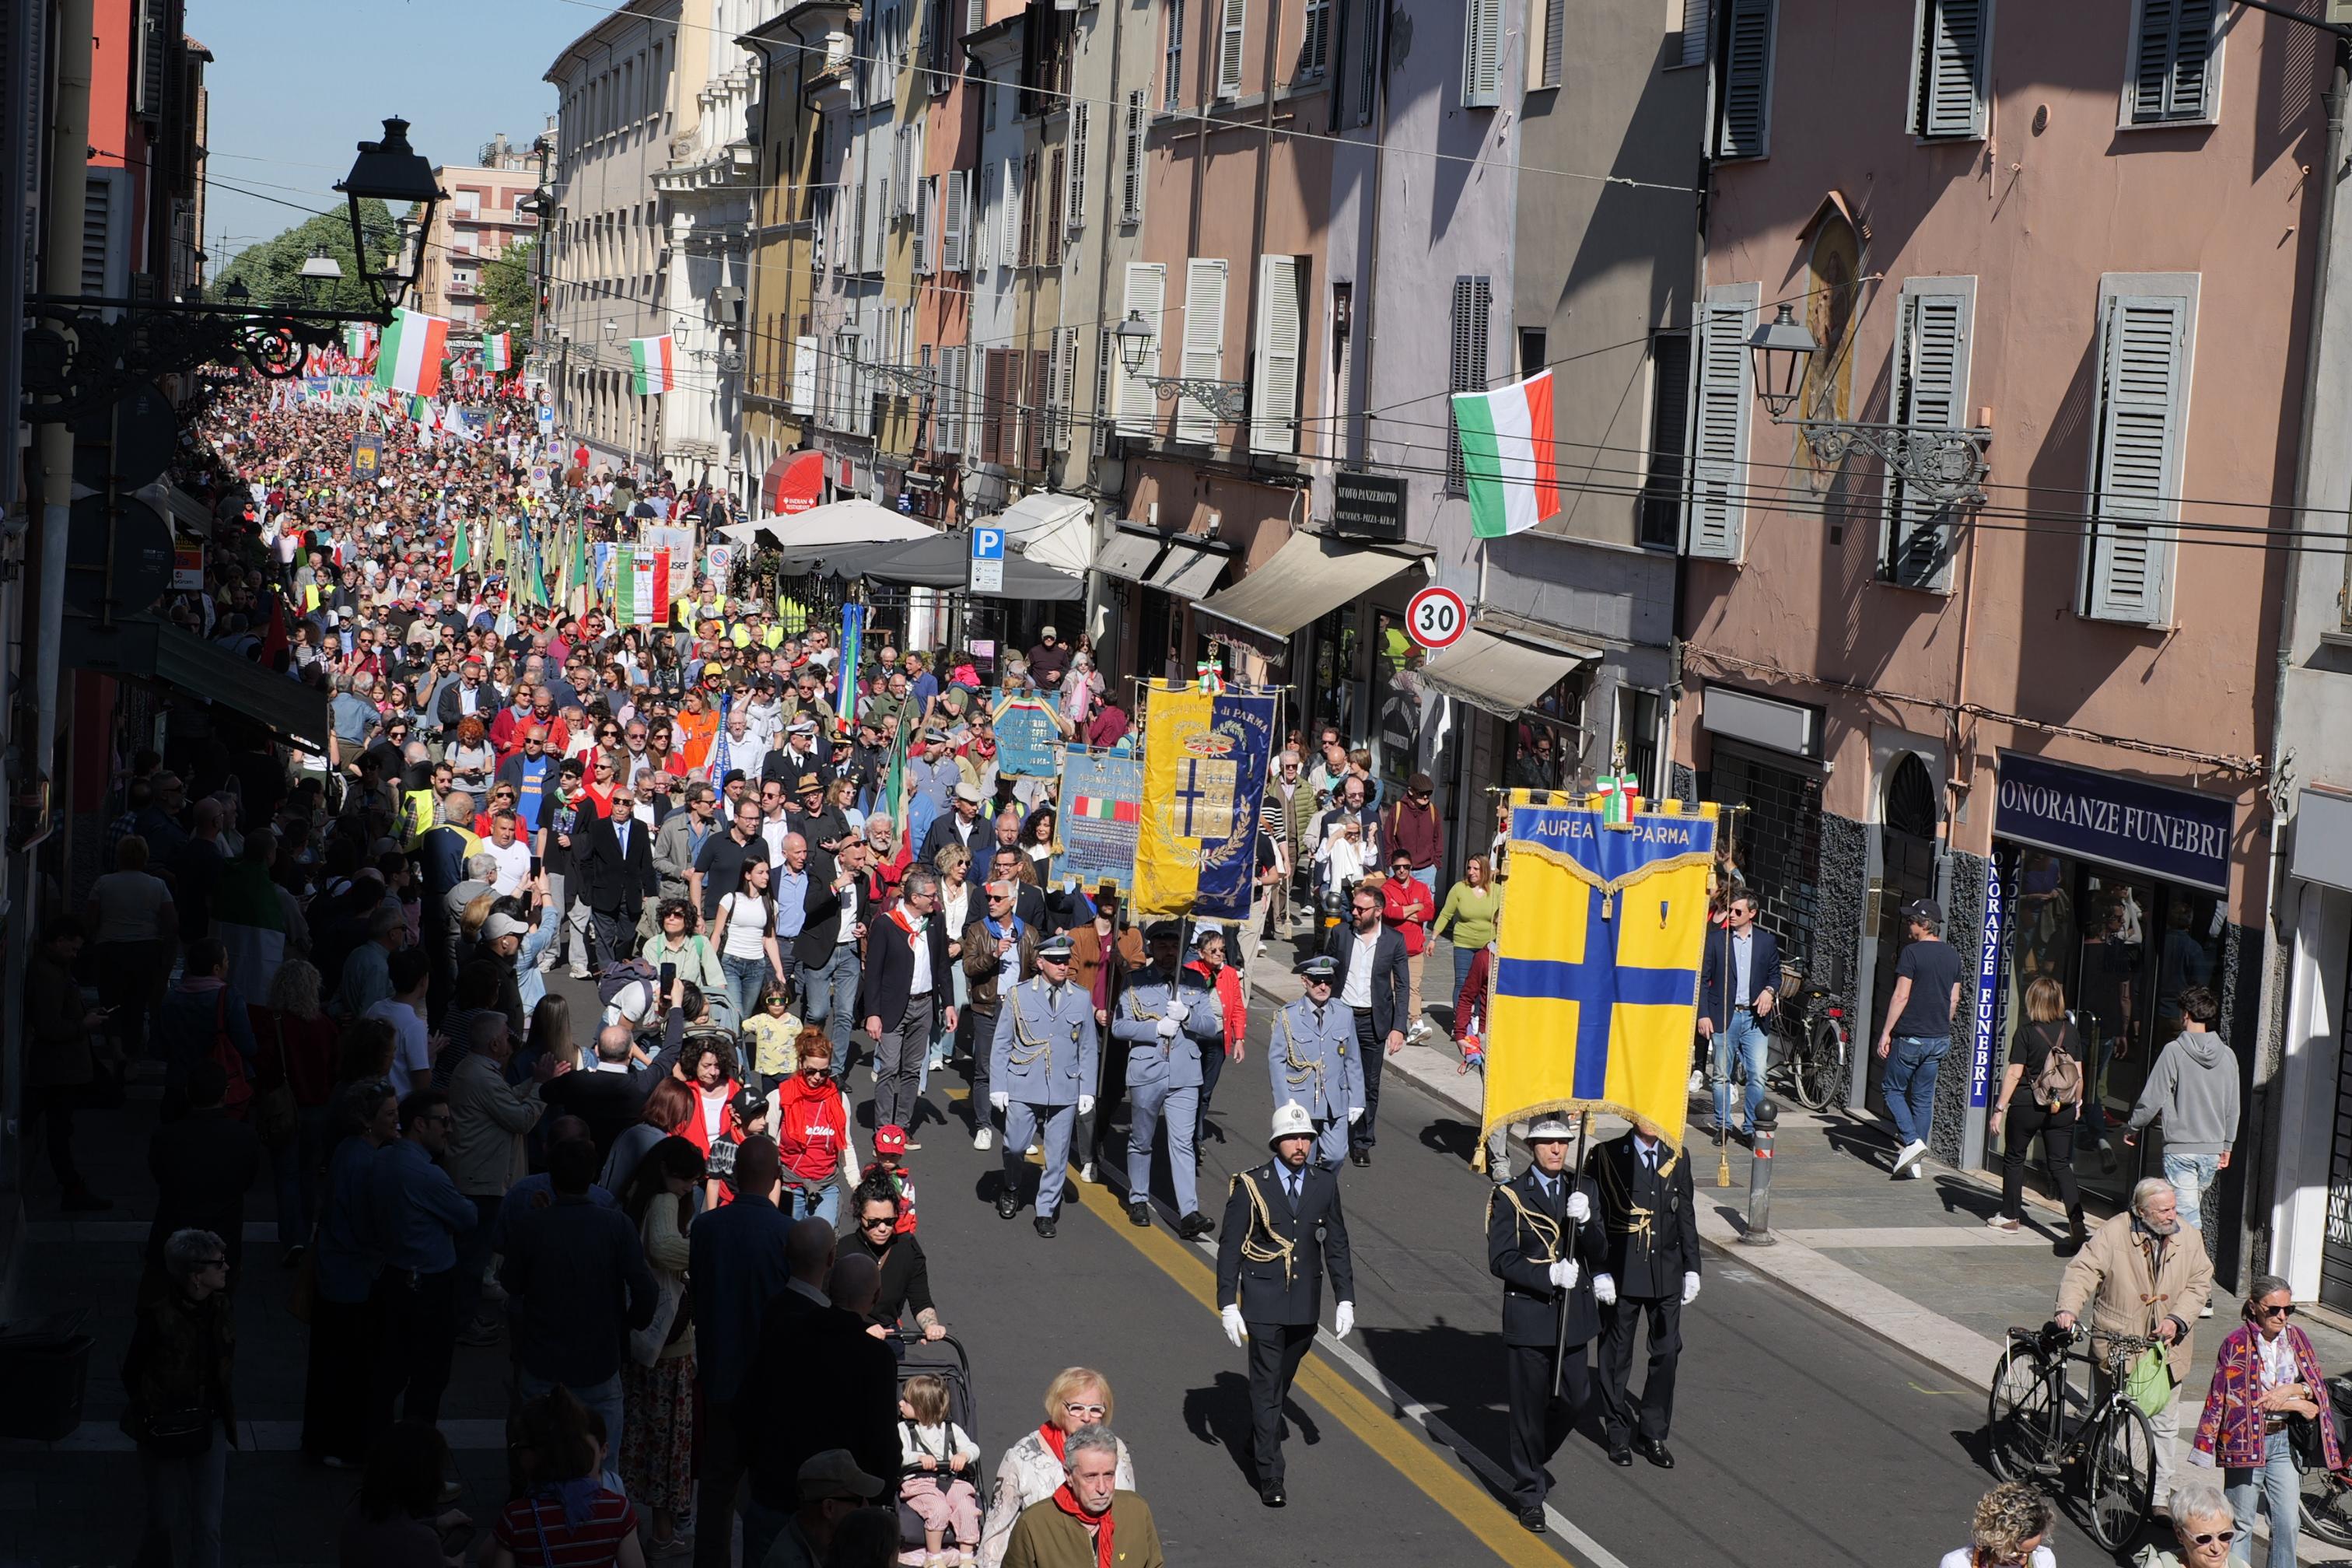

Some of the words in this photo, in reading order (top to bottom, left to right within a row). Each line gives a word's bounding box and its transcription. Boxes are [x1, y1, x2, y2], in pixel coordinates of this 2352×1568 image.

[542, 408, 550, 419] P
[1337, 487, 1358, 499] NUOVO
[1358, 488, 1398, 504] PANZEROTTO
[1336, 510, 1360, 522] COUSCOUS
[1363, 514, 1377, 523] PIZZA
[978, 530, 999, 556] P
[670, 562, 689, 570] user
[1420, 604, 1454, 632] 30
[1220, 705, 1230, 716] di
[1233, 709, 1269, 733] PARMA
[1536, 819, 1594, 839] AUREA
[1632, 825, 1690, 845] PARMA
[2001, 779, 2119, 835] ONORANZE
[2123, 807, 2227, 860] FUNEBRI
[1982, 852, 2004, 976] ONORANZE
[1973, 989, 1993, 1097] FUNEBRI
